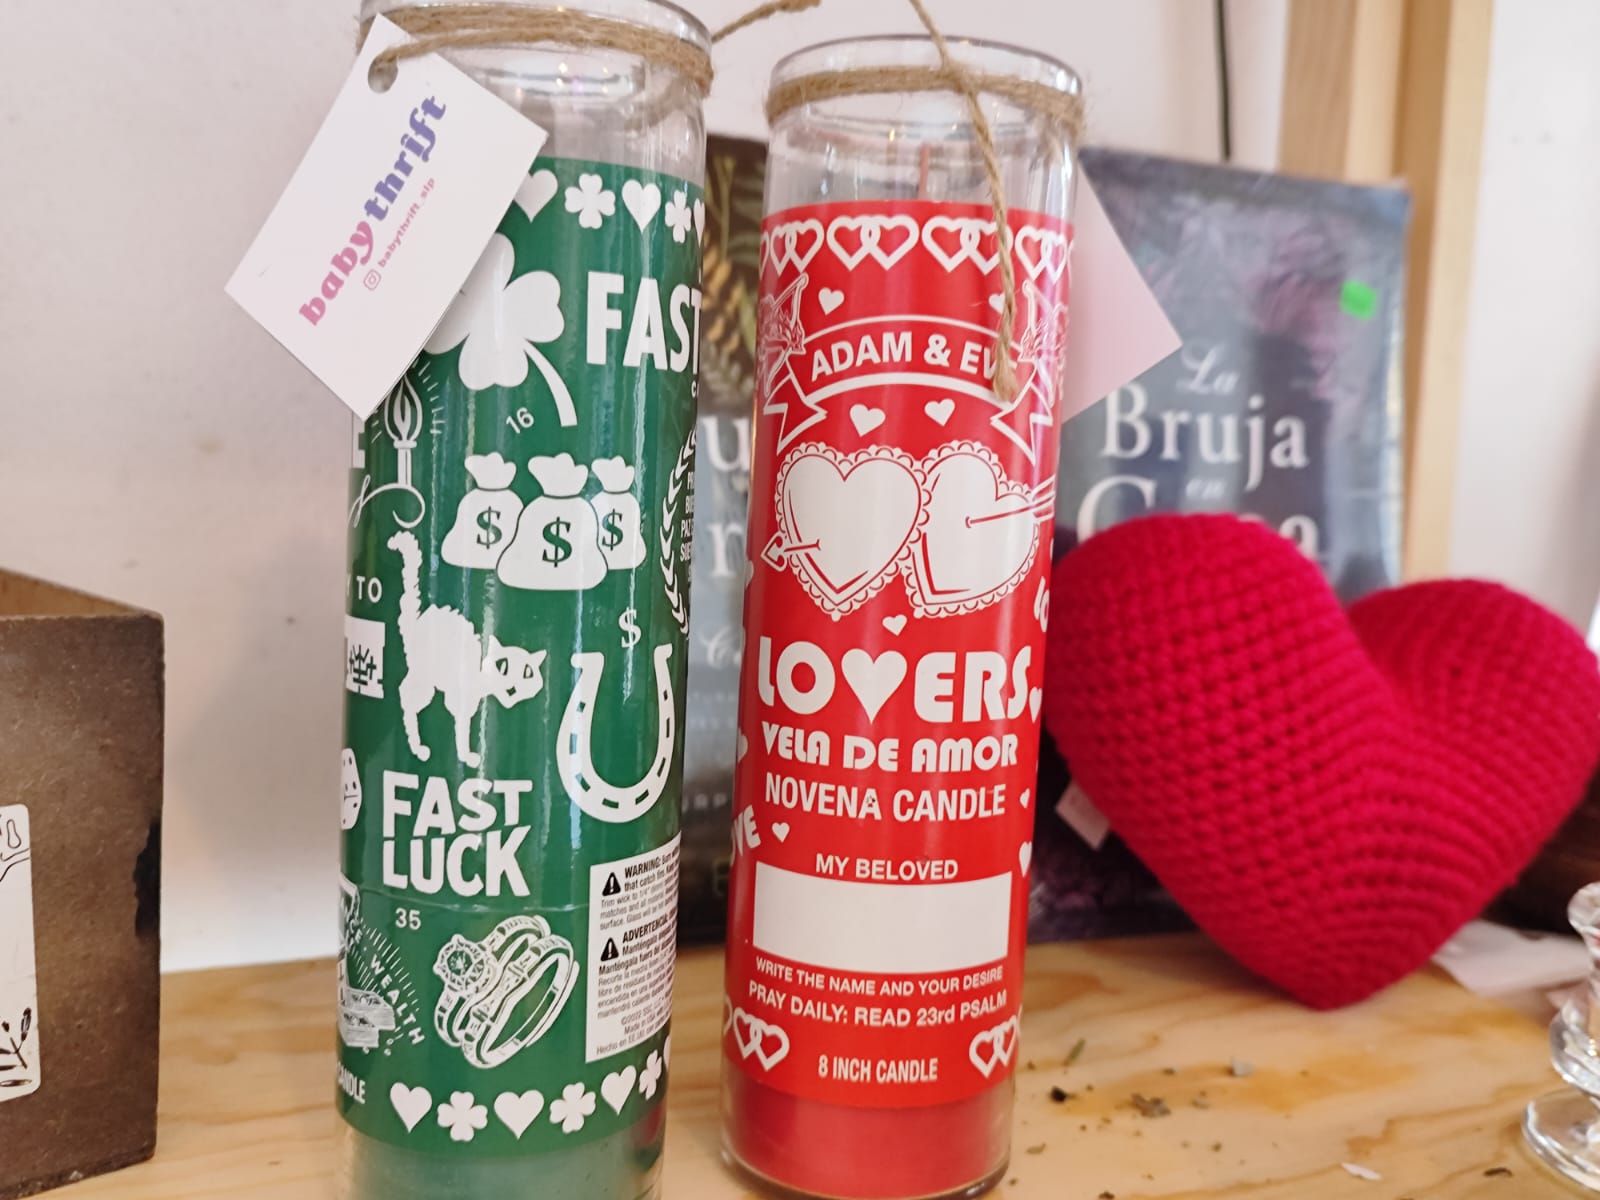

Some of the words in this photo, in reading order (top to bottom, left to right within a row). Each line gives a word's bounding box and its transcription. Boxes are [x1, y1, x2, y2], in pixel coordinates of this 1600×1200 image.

[586, 271, 703, 374] FAST
[811, 331, 912, 382] ADAM
[923, 334, 951, 367] &
[505, 407, 535, 434] 16
[1102, 382, 1310, 491] Bruja
[1185, 477, 1226, 500] en
[476, 506, 502, 550] $
[542, 517, 573, 568] $
[601, 508, 624, 552] $
[356, 575, 383, 603] TO
[618, 607, 642, 649] $
[762, 721, 830, 766] VELA
[843, 735, 899, 772] DE
[911, 734, 1018, 773] AMOR
[383, 770, 533, 838] FAST
[765, 772, 883, 821] NOVENA
[892, 784, 1007, 822] CANDLE
[383, 825, 531, 897] LUCK
[815, 853, 850, 876] MY
[855, 859, 959, 881] BELOVED
[395, 908, 421, 930] 35
[370, 955, 425, 1045] WEALTH
[756, 956, 793, 983] WRITE
[796, 970, 825, 990] THE
[829, 977, 876, 996] NAME
[879, 980, 914, 996] AND
[918, 973, 960, 995] YOUR
[963, 966, 1003, 990] DESIRE
[749, 980, 786, 1009] PRAY
[790, 995, 848, 1024] DAILY:
[854, 1008, 911, 1027] READ
[916, 1005, 955, 1027] 23rd
[960, 989, 1007, 1020] PSALM
[818, 1055, 828, 1078] 8
[833, 1057, 872, 1082] INCH
[876, 1057, 938, 1083] CANDLE
